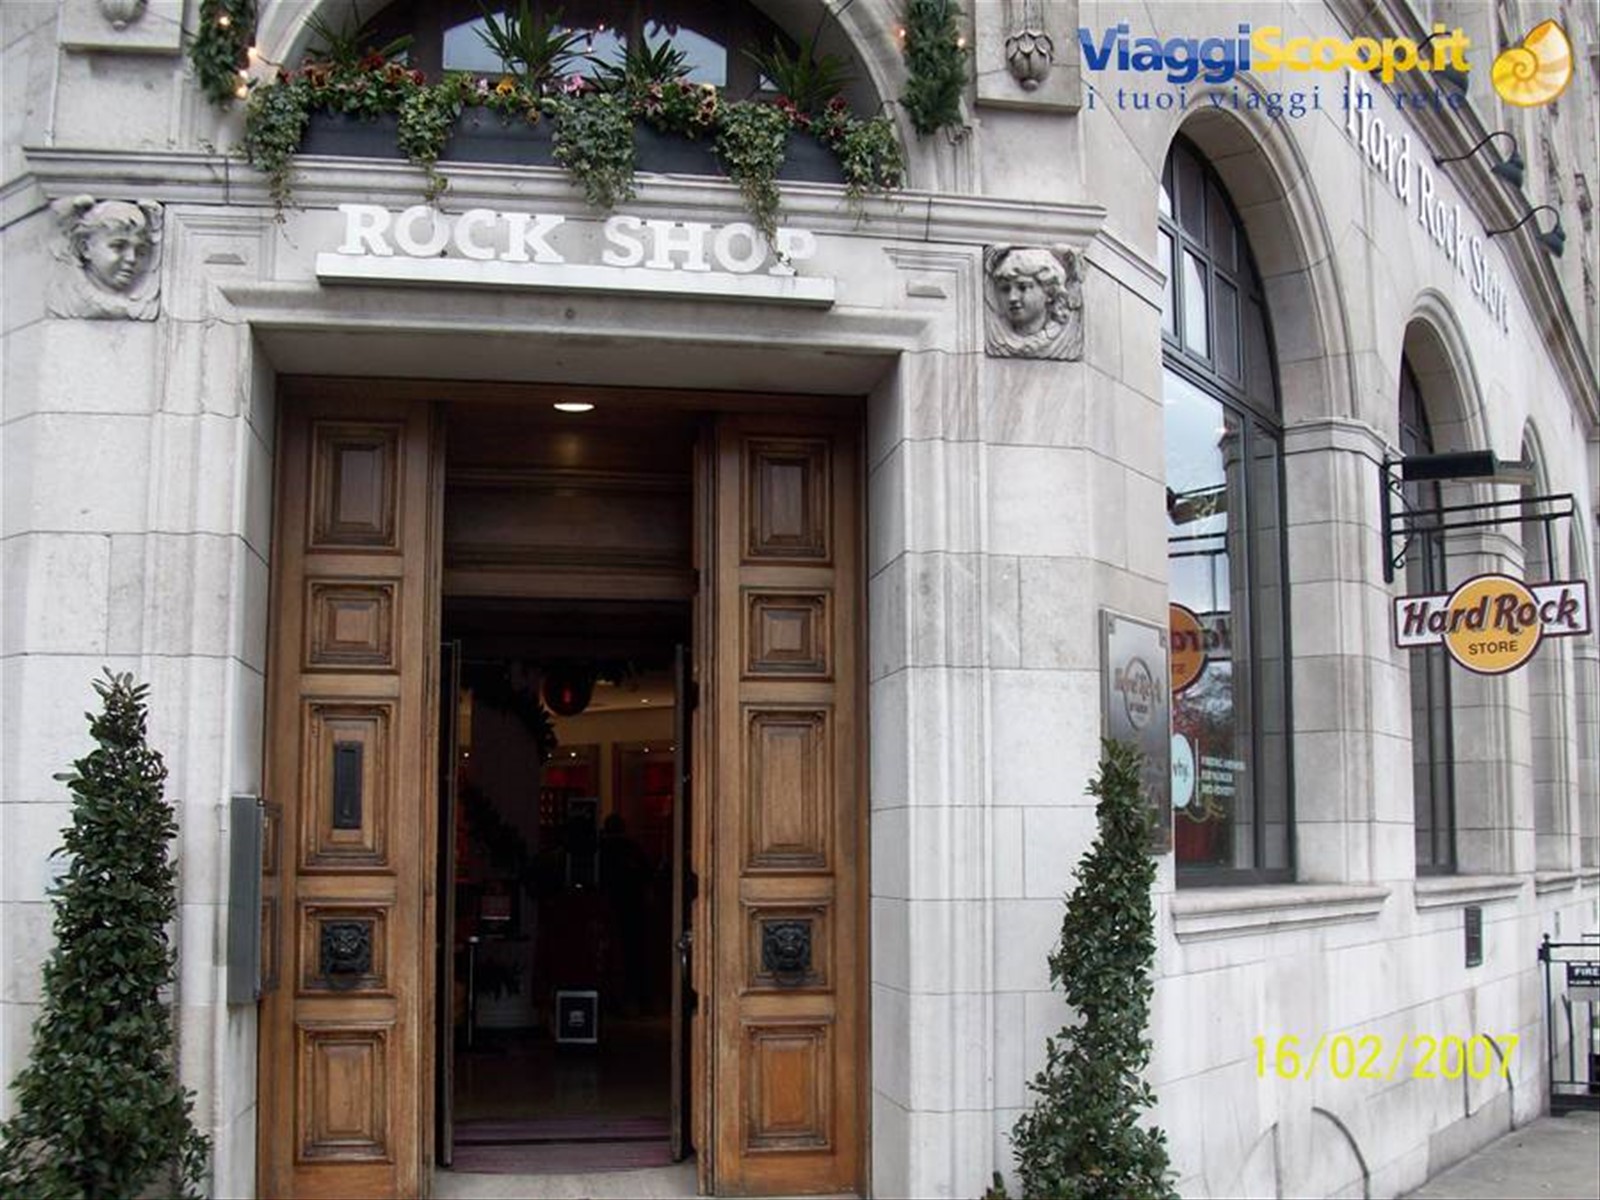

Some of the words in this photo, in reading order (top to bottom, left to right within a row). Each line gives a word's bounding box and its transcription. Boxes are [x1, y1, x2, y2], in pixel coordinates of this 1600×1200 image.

[336, 203, 566, 264] ROCK
[601, 215, 818, 276] SHOP
[1417, 160, 1468, 278] Rock
[1403, 595, 1489, 637] Hard
[1494, 588, 1580, 637] Rock
[1468, 641, 1519, 655] STORE
